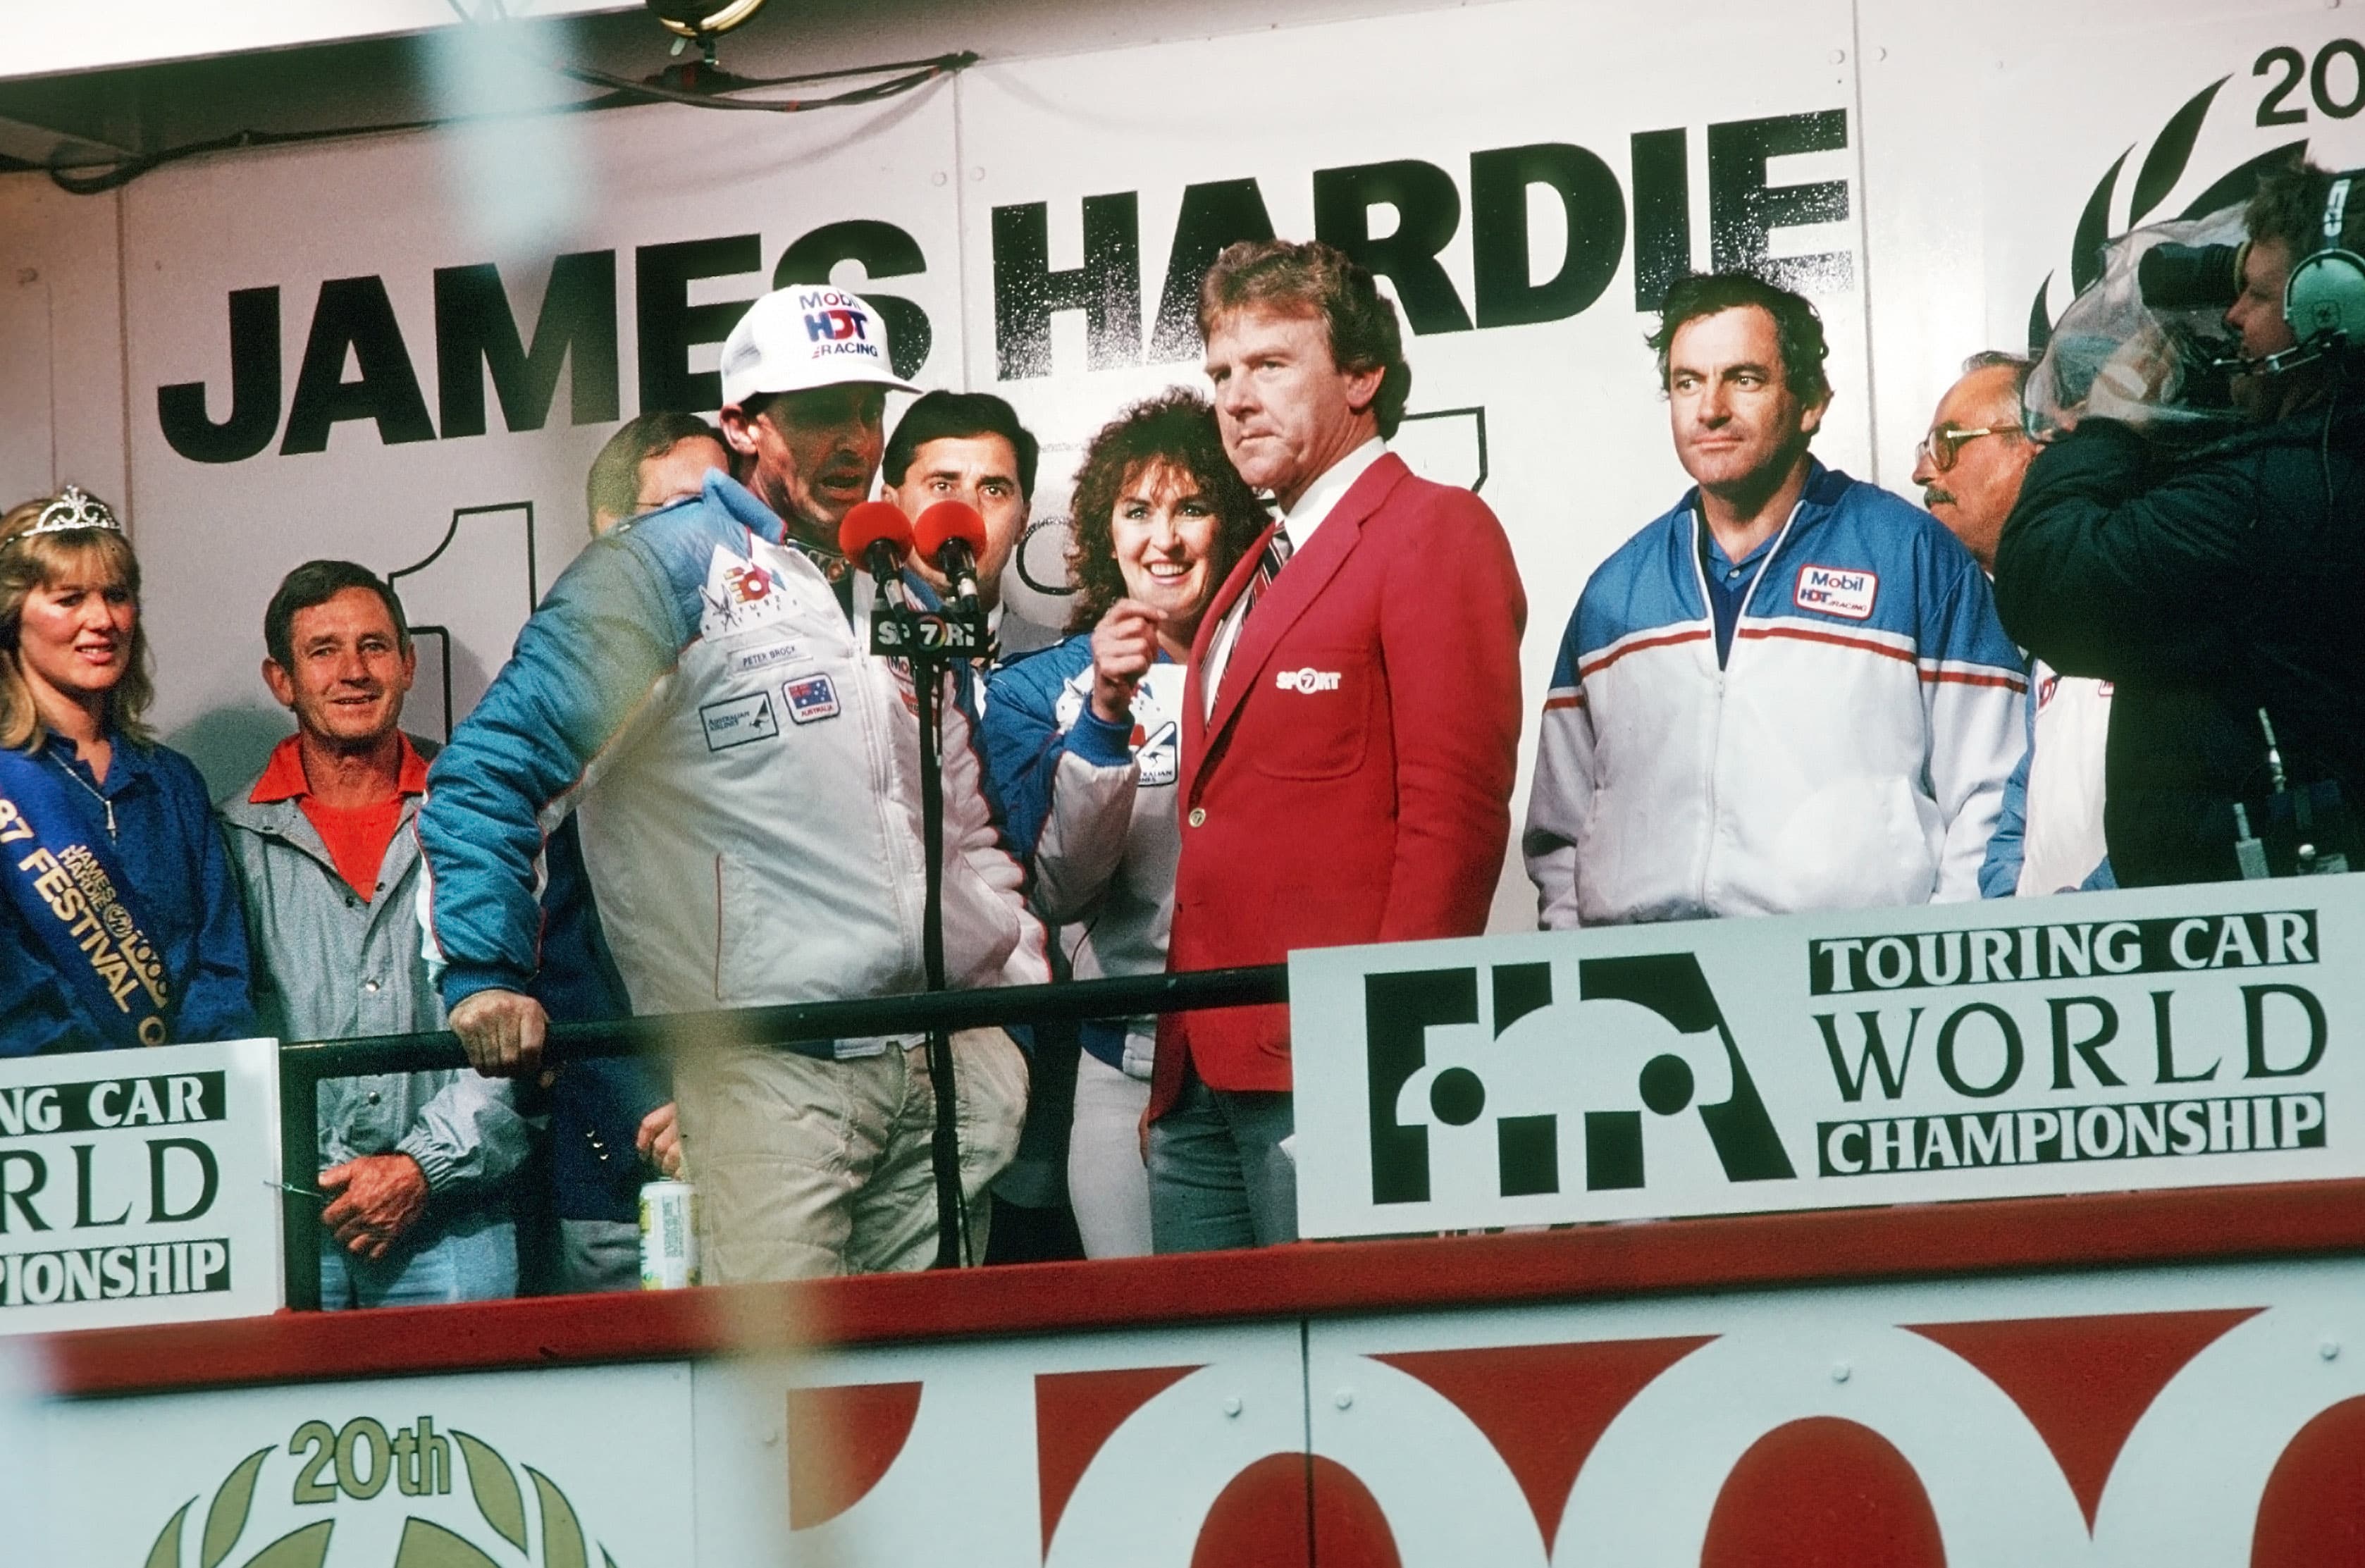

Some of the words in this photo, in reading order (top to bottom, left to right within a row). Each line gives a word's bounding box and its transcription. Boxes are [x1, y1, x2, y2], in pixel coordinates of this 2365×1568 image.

[157, 218, 932, 464] JAMES
[991, 108, 1853, 381] HARDIE
[804, 309, 868, 342] HDT
[820, 342, 878, 357] RACING
[1800, 588, 1832, 603] HDT
[1810, 571, 1864, 592] Mobil
[1830, 601, 1867, 612] RACING
[742, 653, 767, 667] PETER
[770, 646, 795, 659] BROCK
[801, 704, 833, 717] AUSTRALIA
[57, 845, 104, 912] HARDIE
[74, 845, 116, 903] JAMES
[18, 847, 140, 1013] FESTIVAL
[1818, 921, 2142, 992] TOURING
[2170, 912, 2313, 968] CAR
[1813, 983, 2328, 1103] WORLD
[88, 1075, 207, 1128] CAR
[1827, 1094, 2324, 1173] CHAMPIONSHIP
[0, 1137, 219, 1234] RLD
[0, 1241, 226, 1306] IONSHIP
[288, 1415, 451, 1505] 20th
